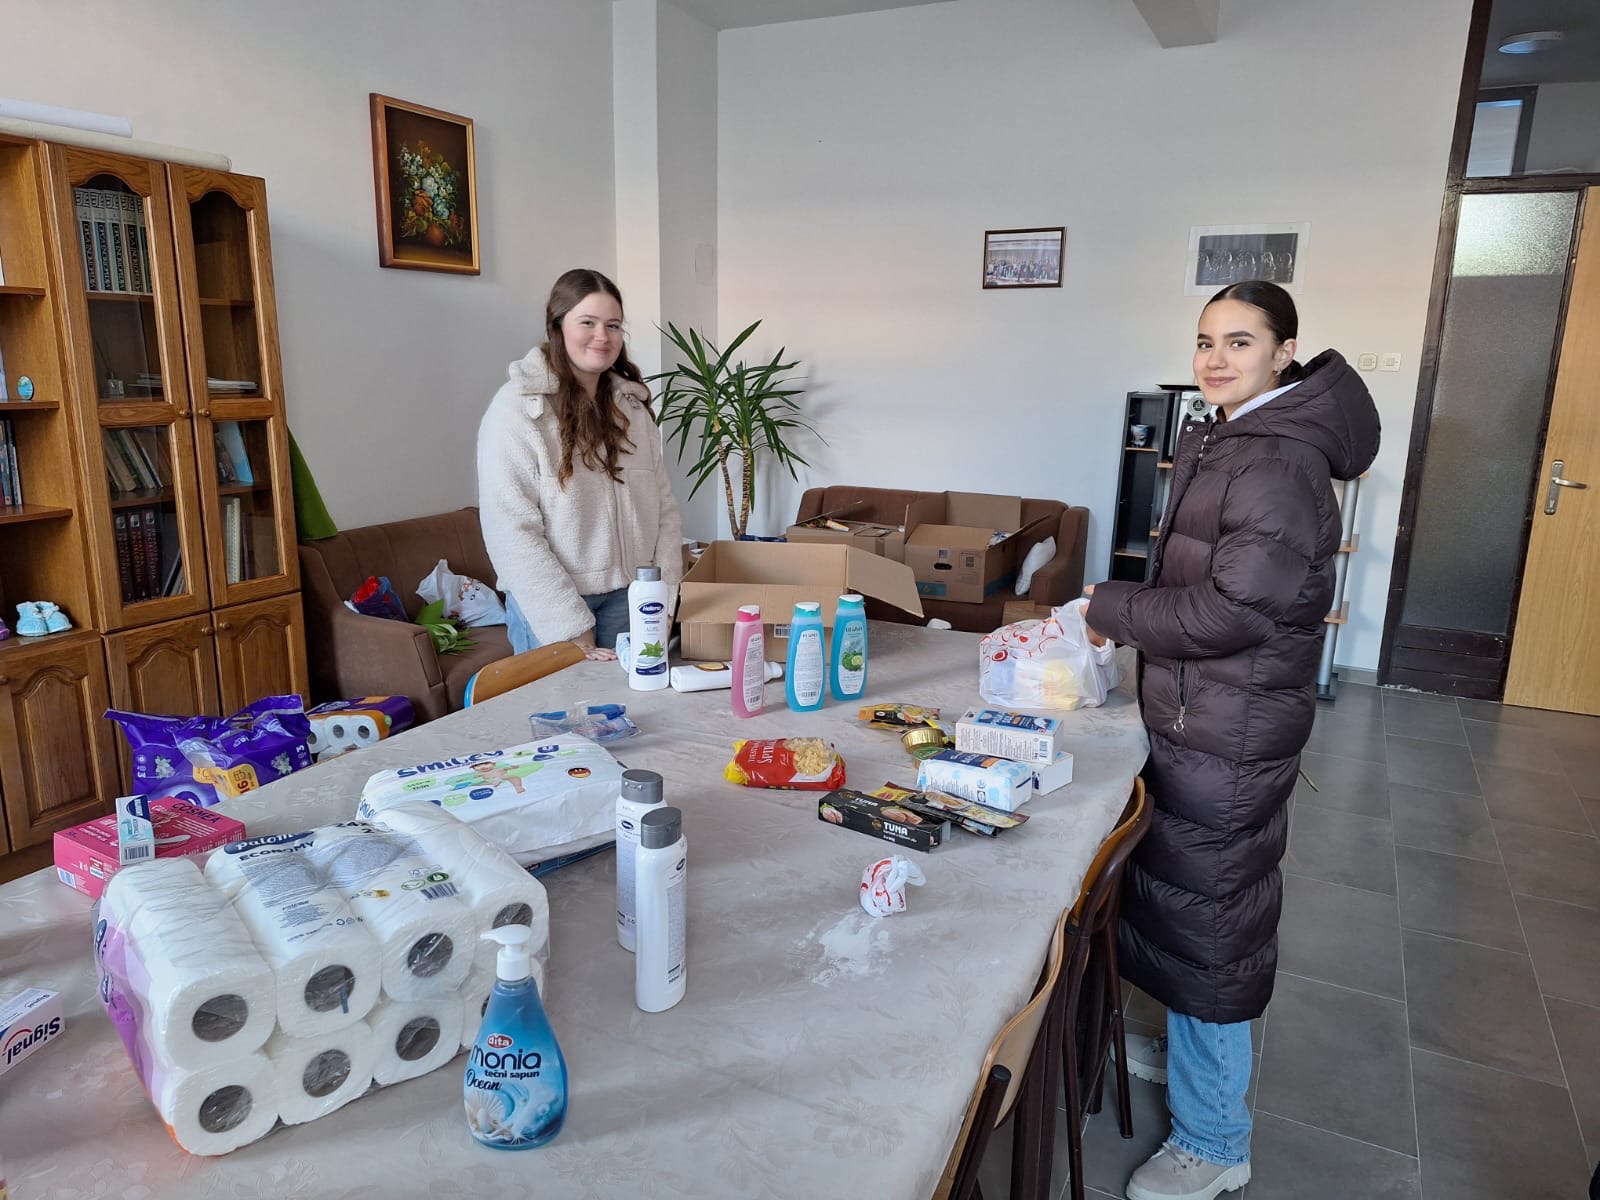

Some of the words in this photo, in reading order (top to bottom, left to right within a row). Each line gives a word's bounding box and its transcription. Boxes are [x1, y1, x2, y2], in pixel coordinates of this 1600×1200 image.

[172, 803, 221, 823] COSMEA
[883, 821, 908, 836] TUNA
[6, 1016, 61, 1065] Signal
[466, 1068, 503, 1091] Ocean
[484, 1069, 508, 1079] tečni
[509, 1070, 540, 1080] sapun
